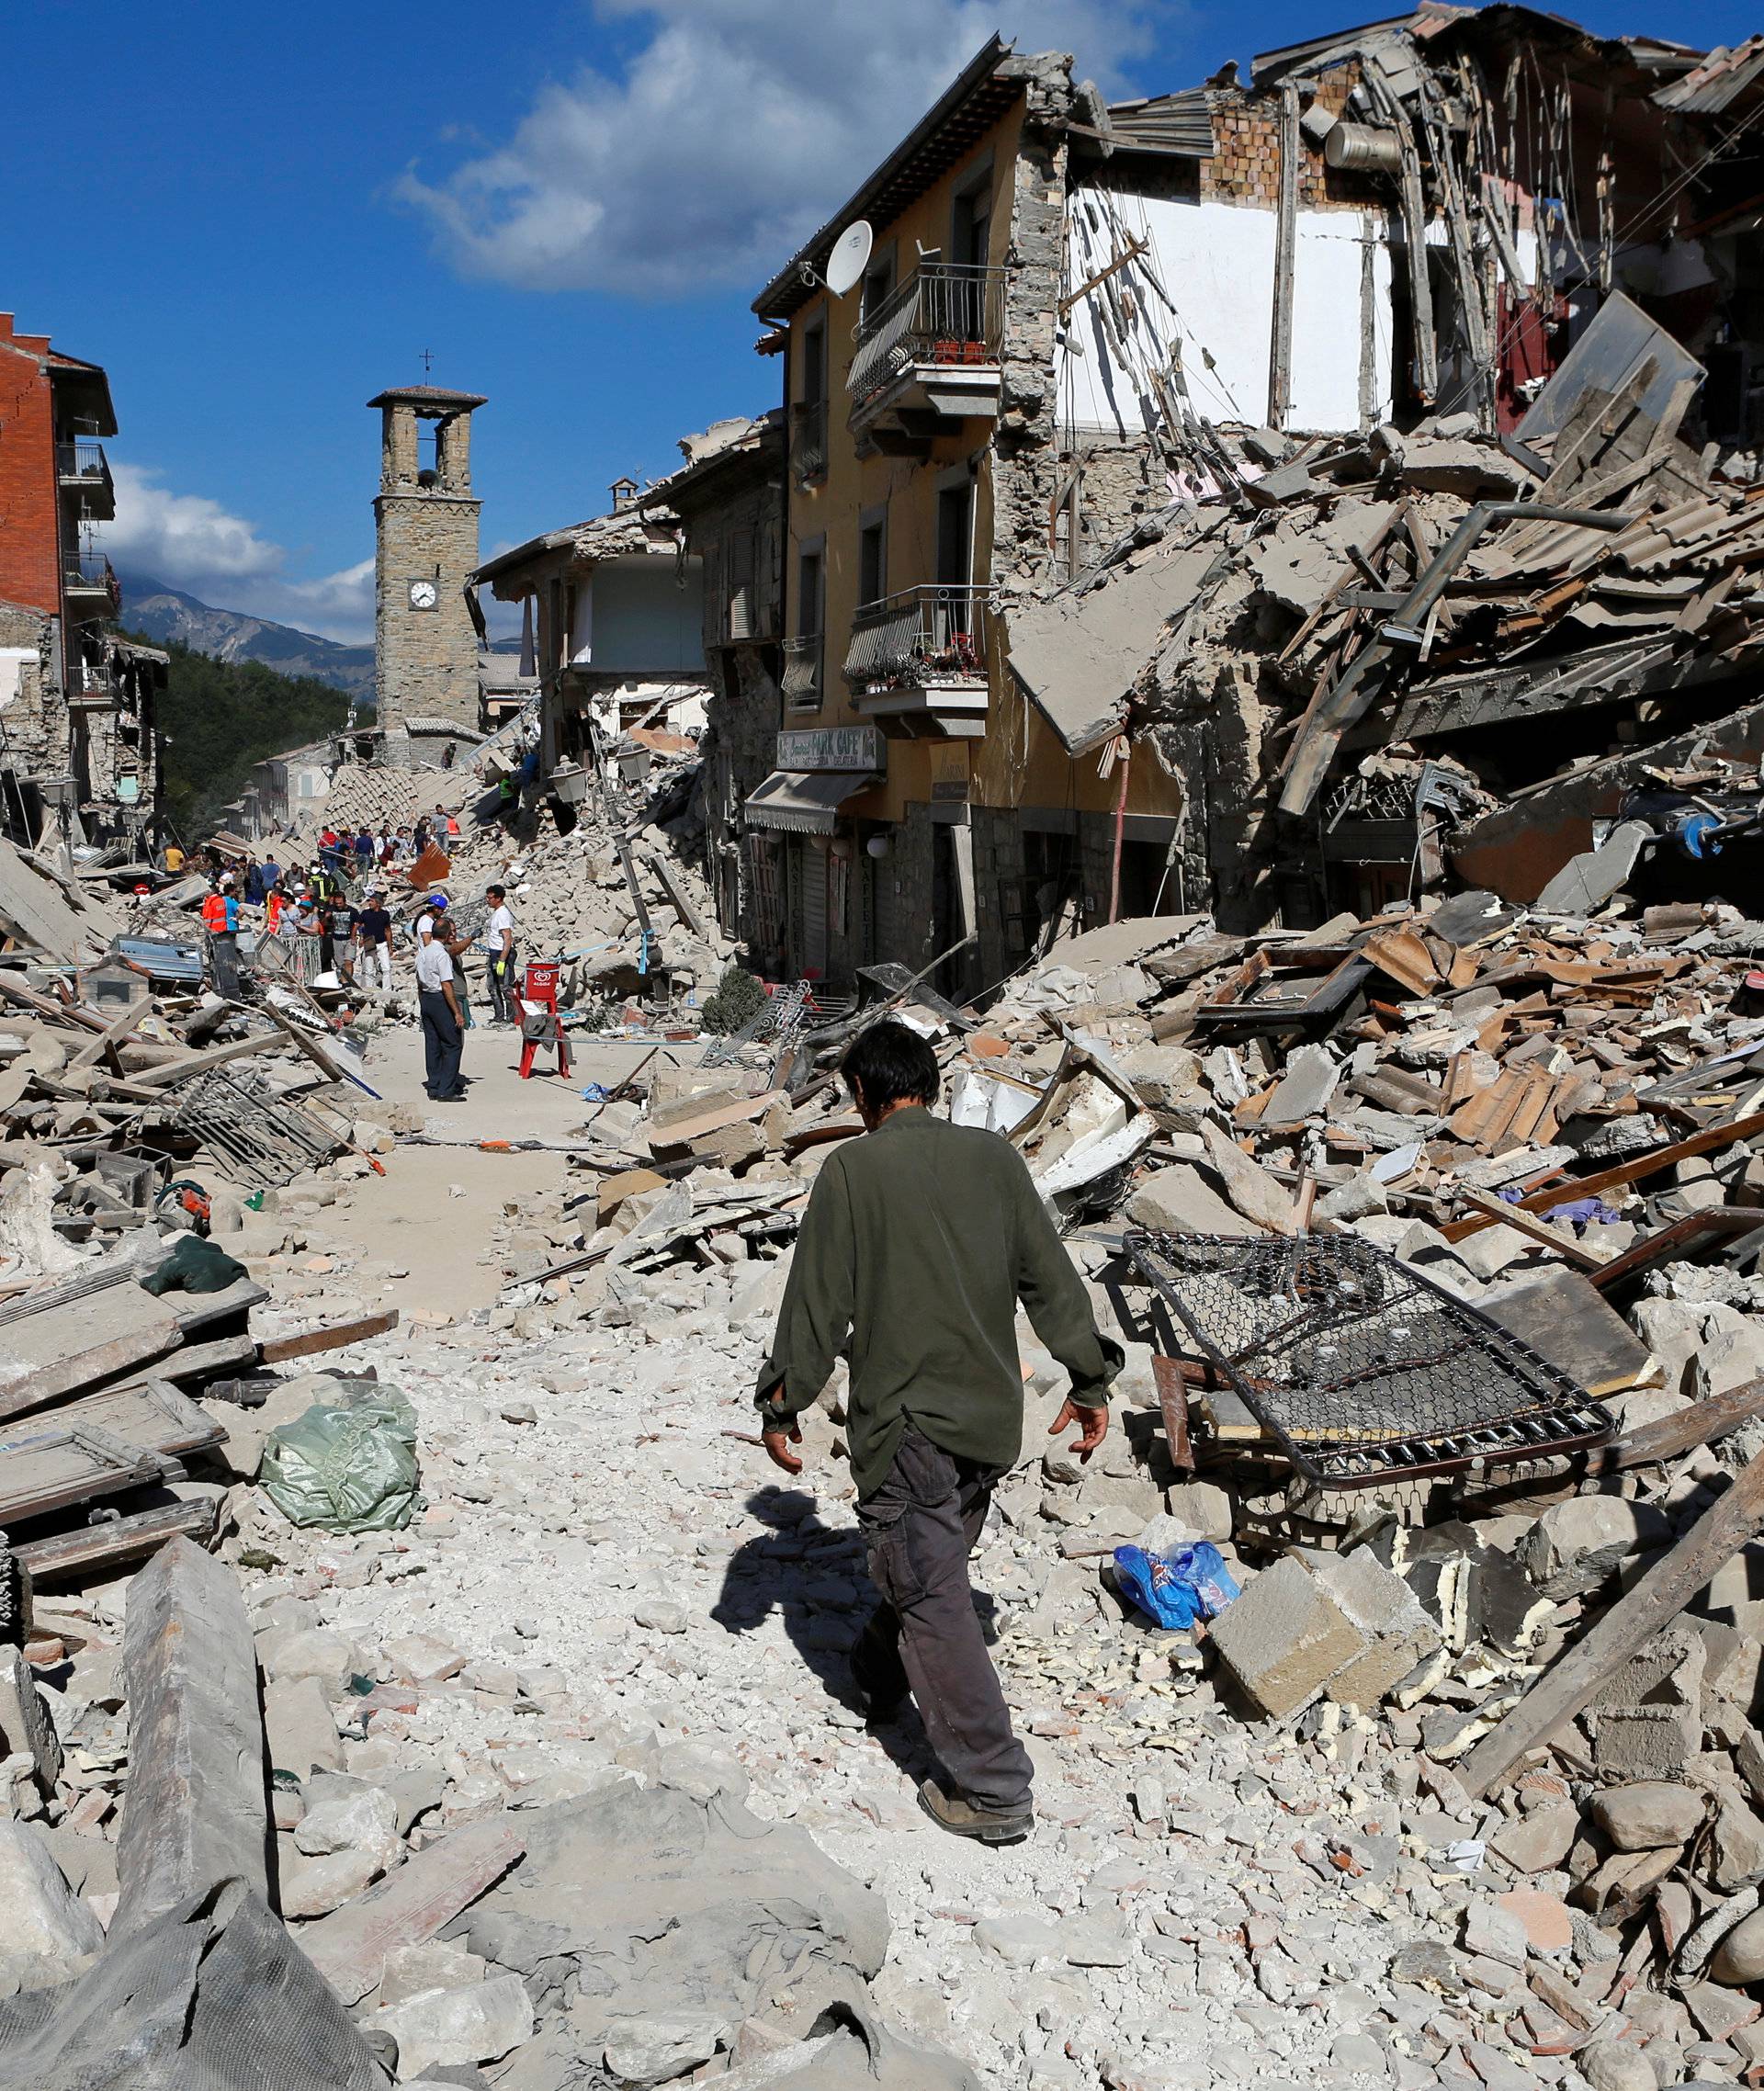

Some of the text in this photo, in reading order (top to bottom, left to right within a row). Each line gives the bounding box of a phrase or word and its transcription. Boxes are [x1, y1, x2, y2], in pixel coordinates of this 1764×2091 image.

[810, 732, 833, 754] PARK
[791, 847, 801, 978] PASTICCERIA
[860, 857, 871, 962] CAFFETTE
